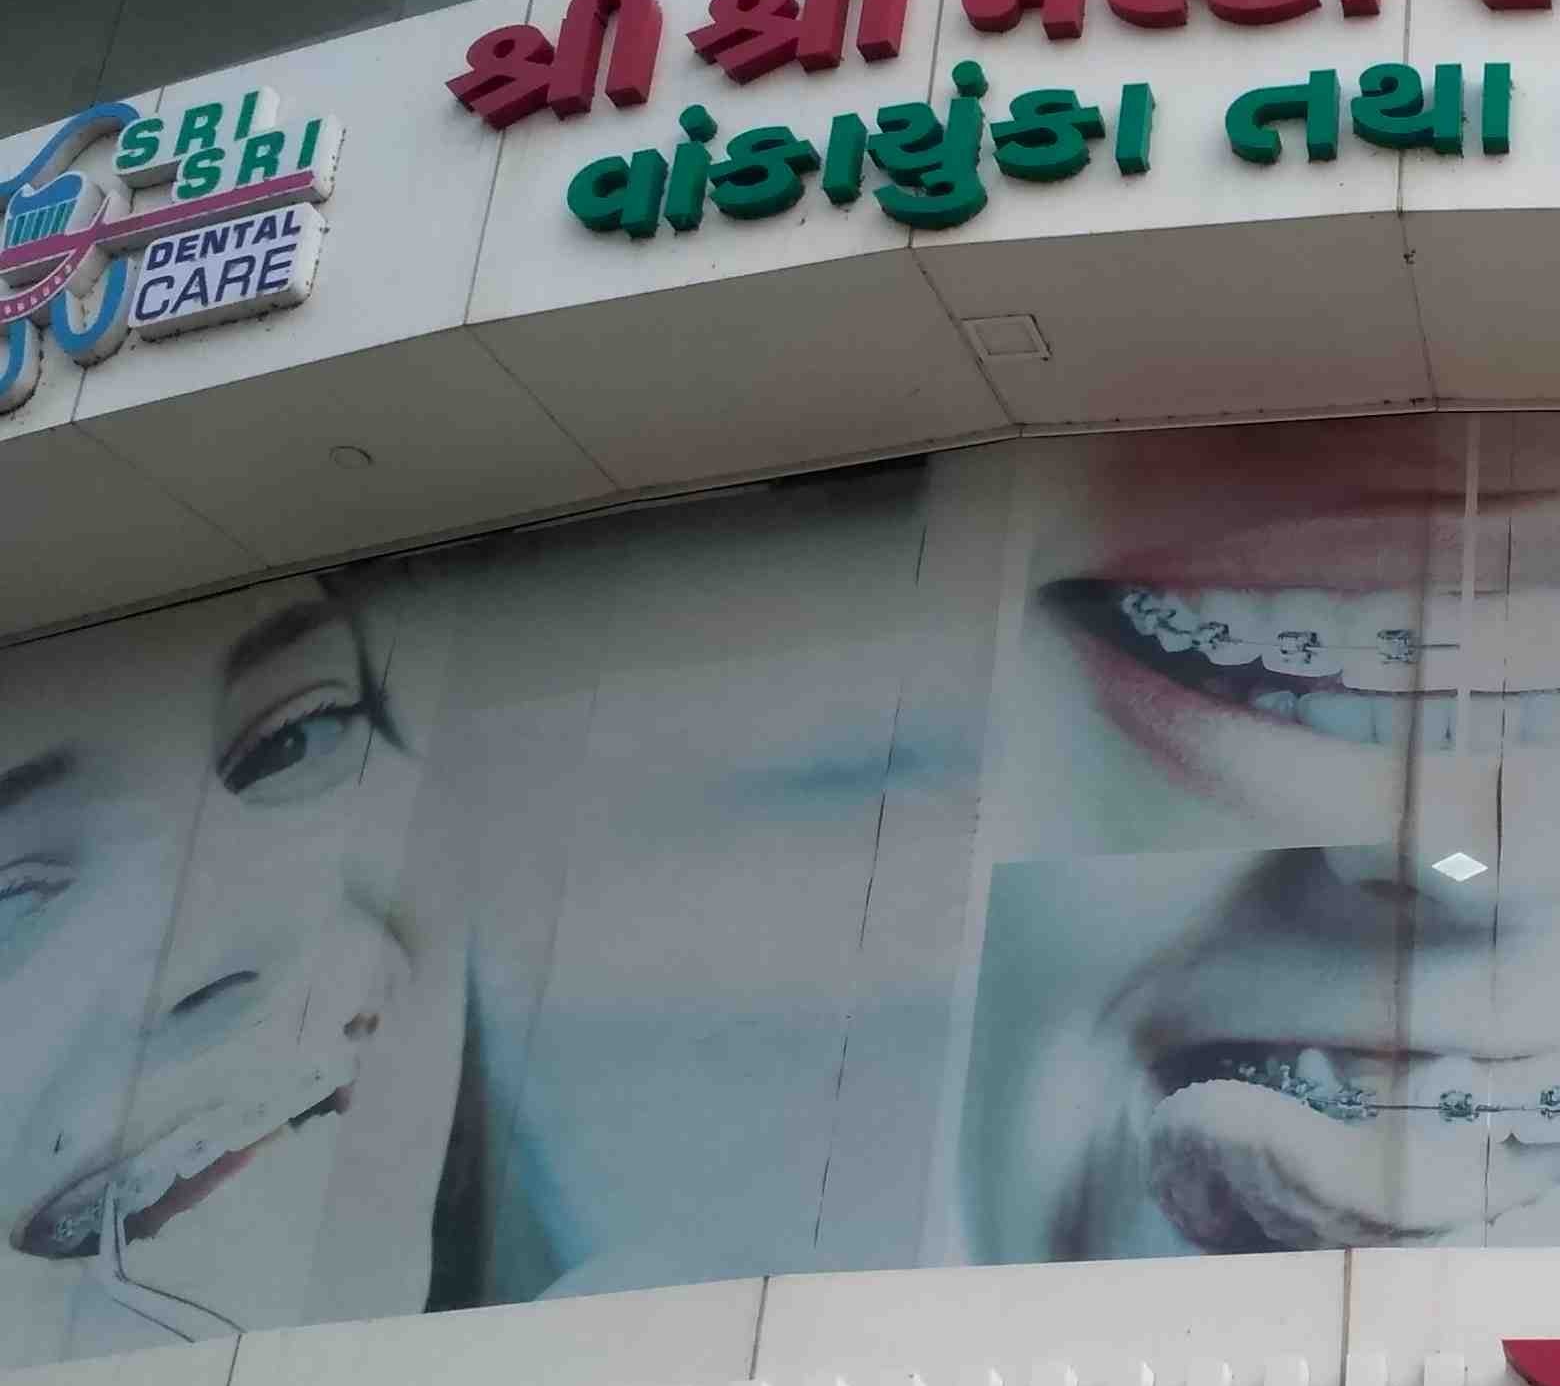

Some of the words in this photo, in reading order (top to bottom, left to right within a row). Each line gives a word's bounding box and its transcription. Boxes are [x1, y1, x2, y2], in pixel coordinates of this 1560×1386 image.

[115, 90, 261, 169] SRI
[1225, 62, 1514, 164] તથા
[176, 118, 323, 201] SRI
[146, 210, 303, 271] DENTAL
[134, 243, 299, 321] CARE
